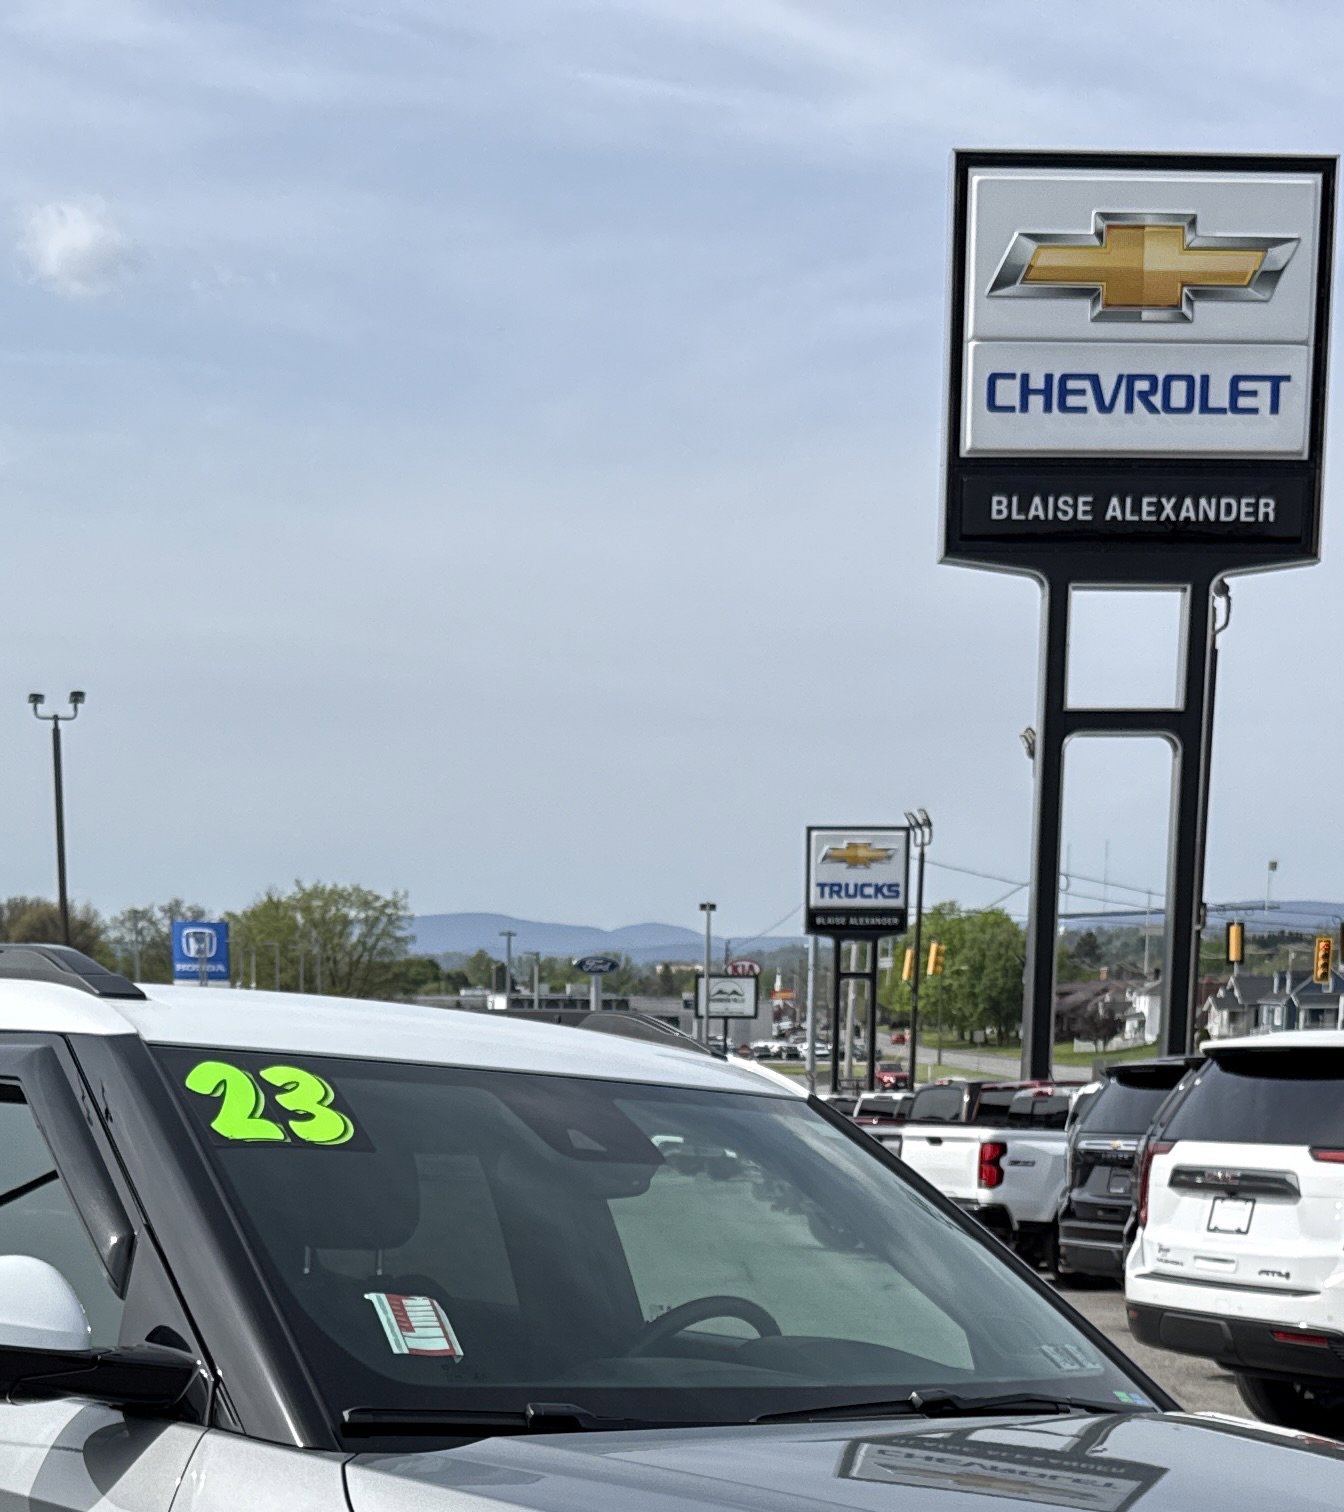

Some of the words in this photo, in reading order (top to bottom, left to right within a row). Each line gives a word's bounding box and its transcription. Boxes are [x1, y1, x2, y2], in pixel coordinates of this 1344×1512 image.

[986, 372, 1292, 416] CHEVROLET
[990, 494, 1094, 522] BLAISE
[1104, 497, 1276, 523] ALEXANDER
[816, 882, 901, 900] TRUCKS
[175, 964, 225, 972] HODA
[185, 1061, 355, 1146] 23
